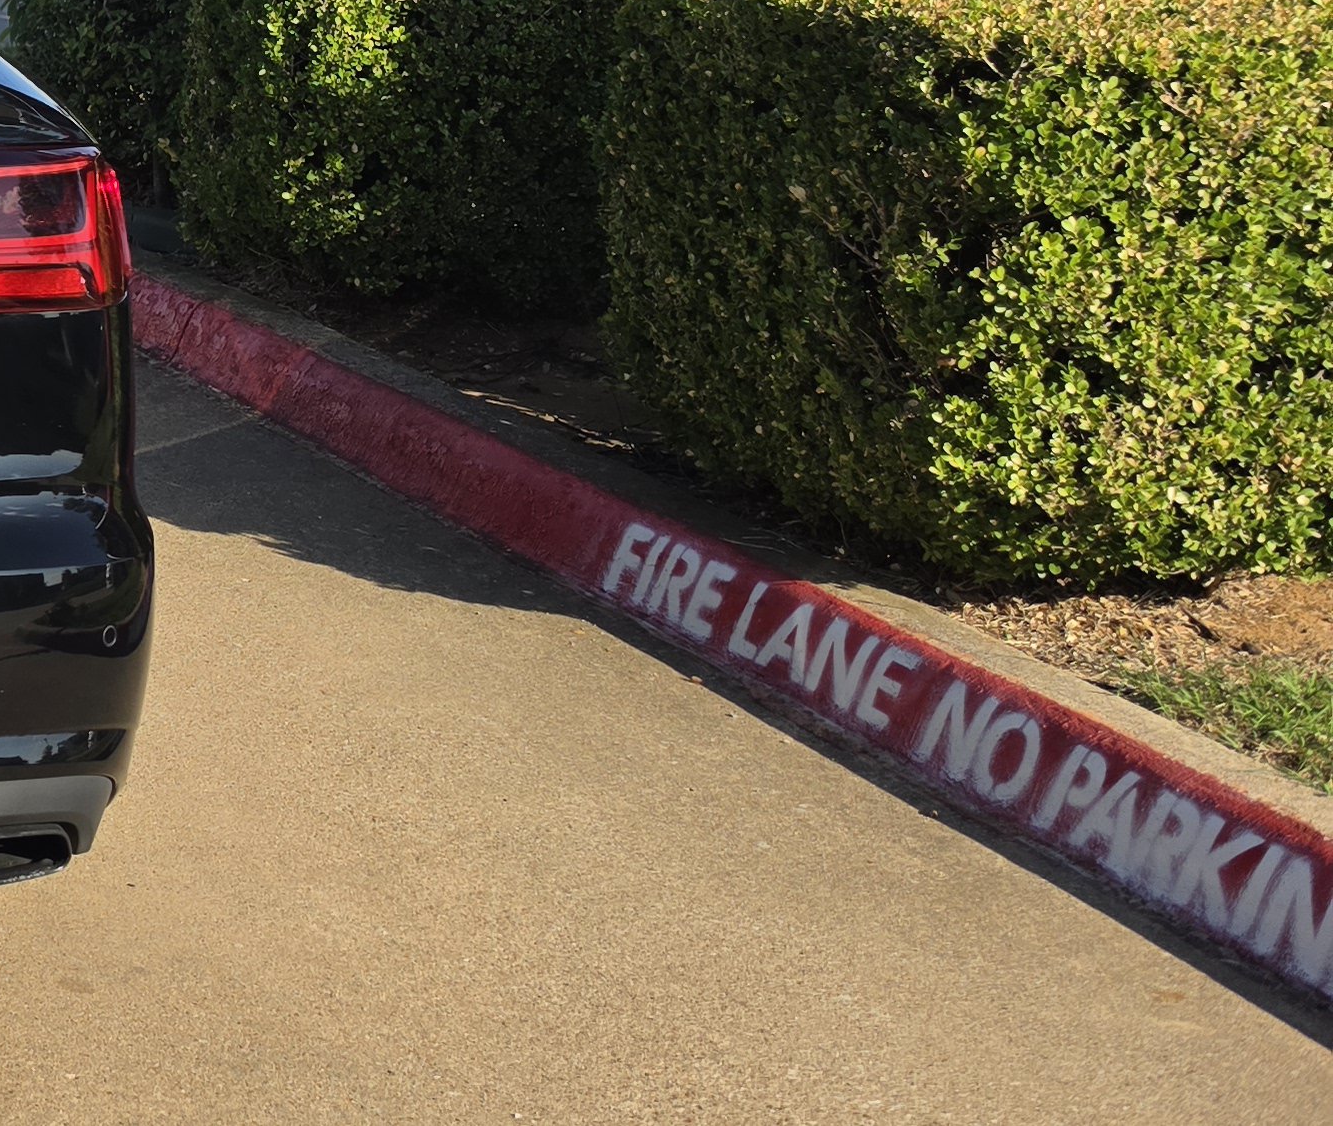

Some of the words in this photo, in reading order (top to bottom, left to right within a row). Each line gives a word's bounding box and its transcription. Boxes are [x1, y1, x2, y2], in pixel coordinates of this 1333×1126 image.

[603, 522, 737, 642] FIRE
[728, 580, 924, 731] LANE
[914, 680, 1040, 806] NO
